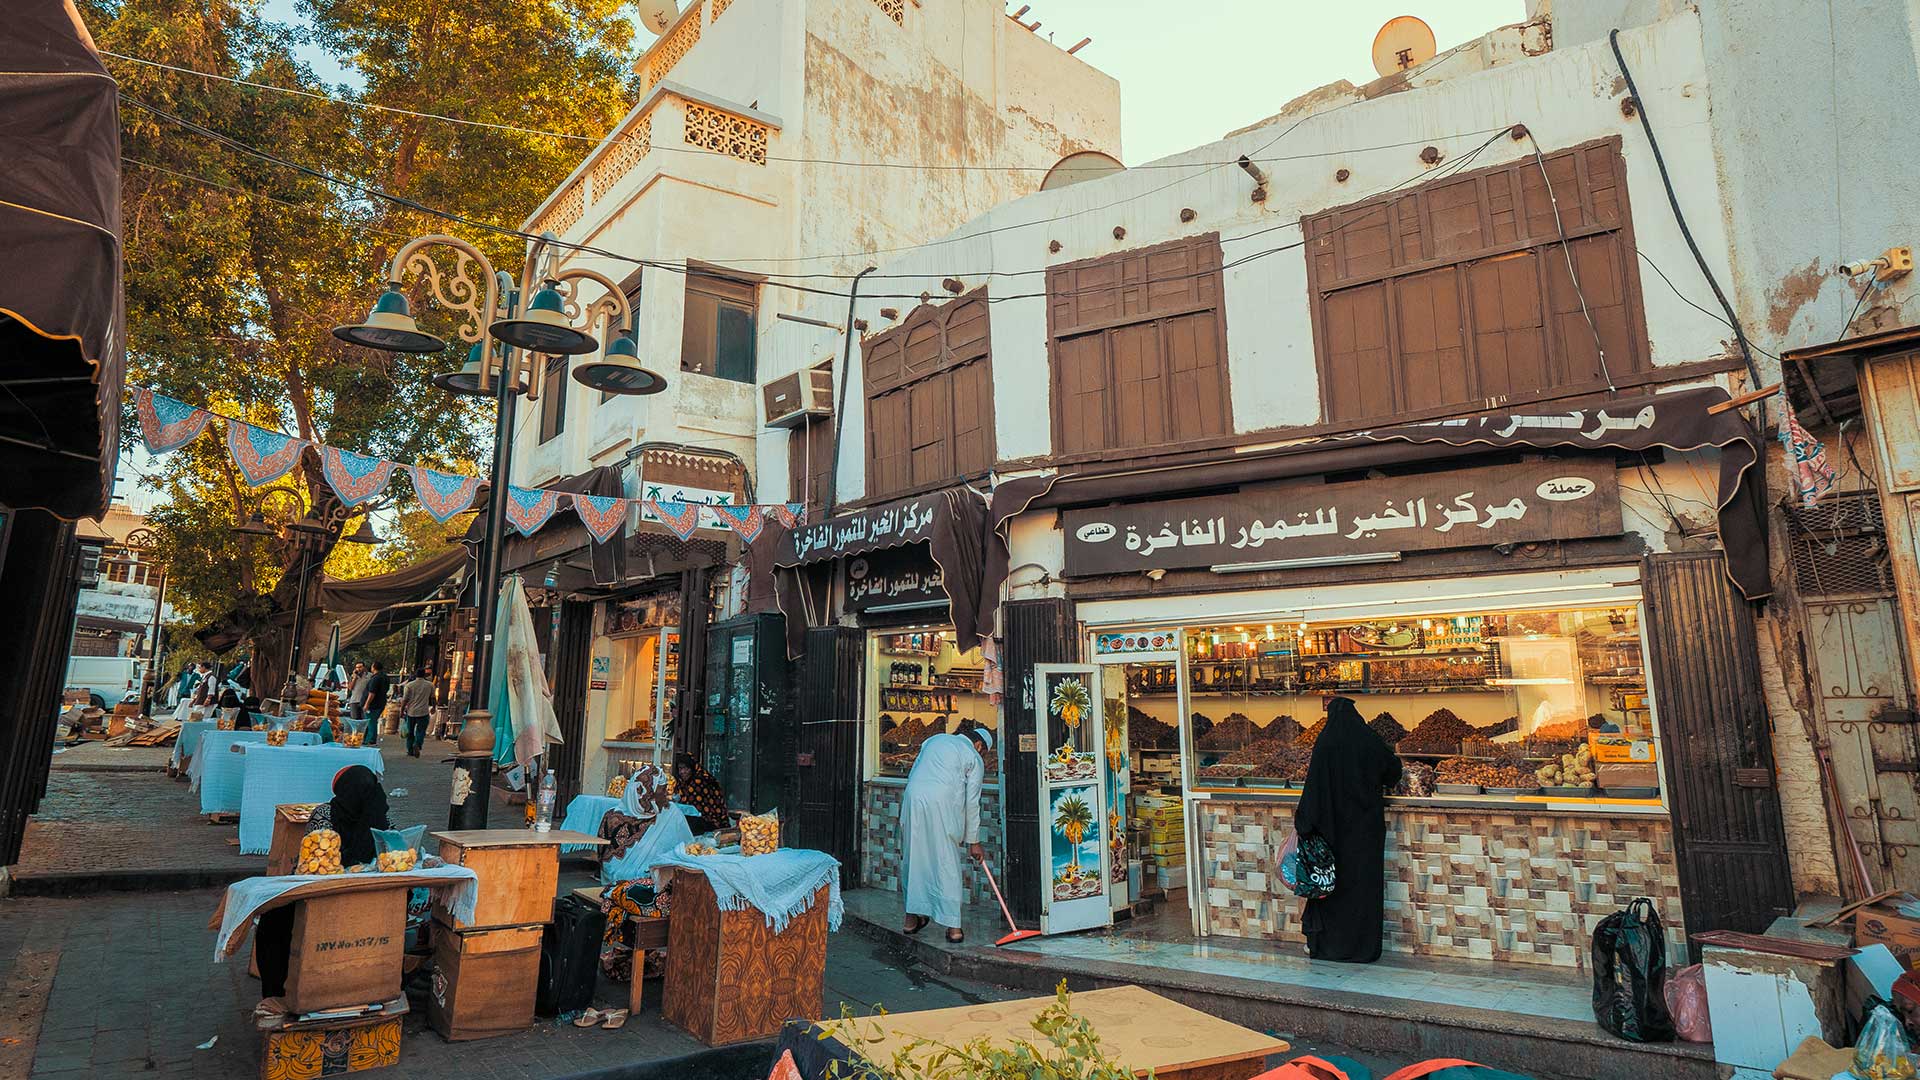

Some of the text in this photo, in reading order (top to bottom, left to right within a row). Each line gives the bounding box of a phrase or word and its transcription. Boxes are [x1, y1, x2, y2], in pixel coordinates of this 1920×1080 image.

[1547, 483, 1586, 495] جملة
[794, 501, 934, 560] مركز الخير للتمور الفاخرة
[1083, 525, 1110, 540] قطاعي
[1125, 491, 1528, 556] مركز الخير للتمور الفاخرة
[849, 576, 887, 601] الفاخرة
[887, 572, 919, 597] للتمور
